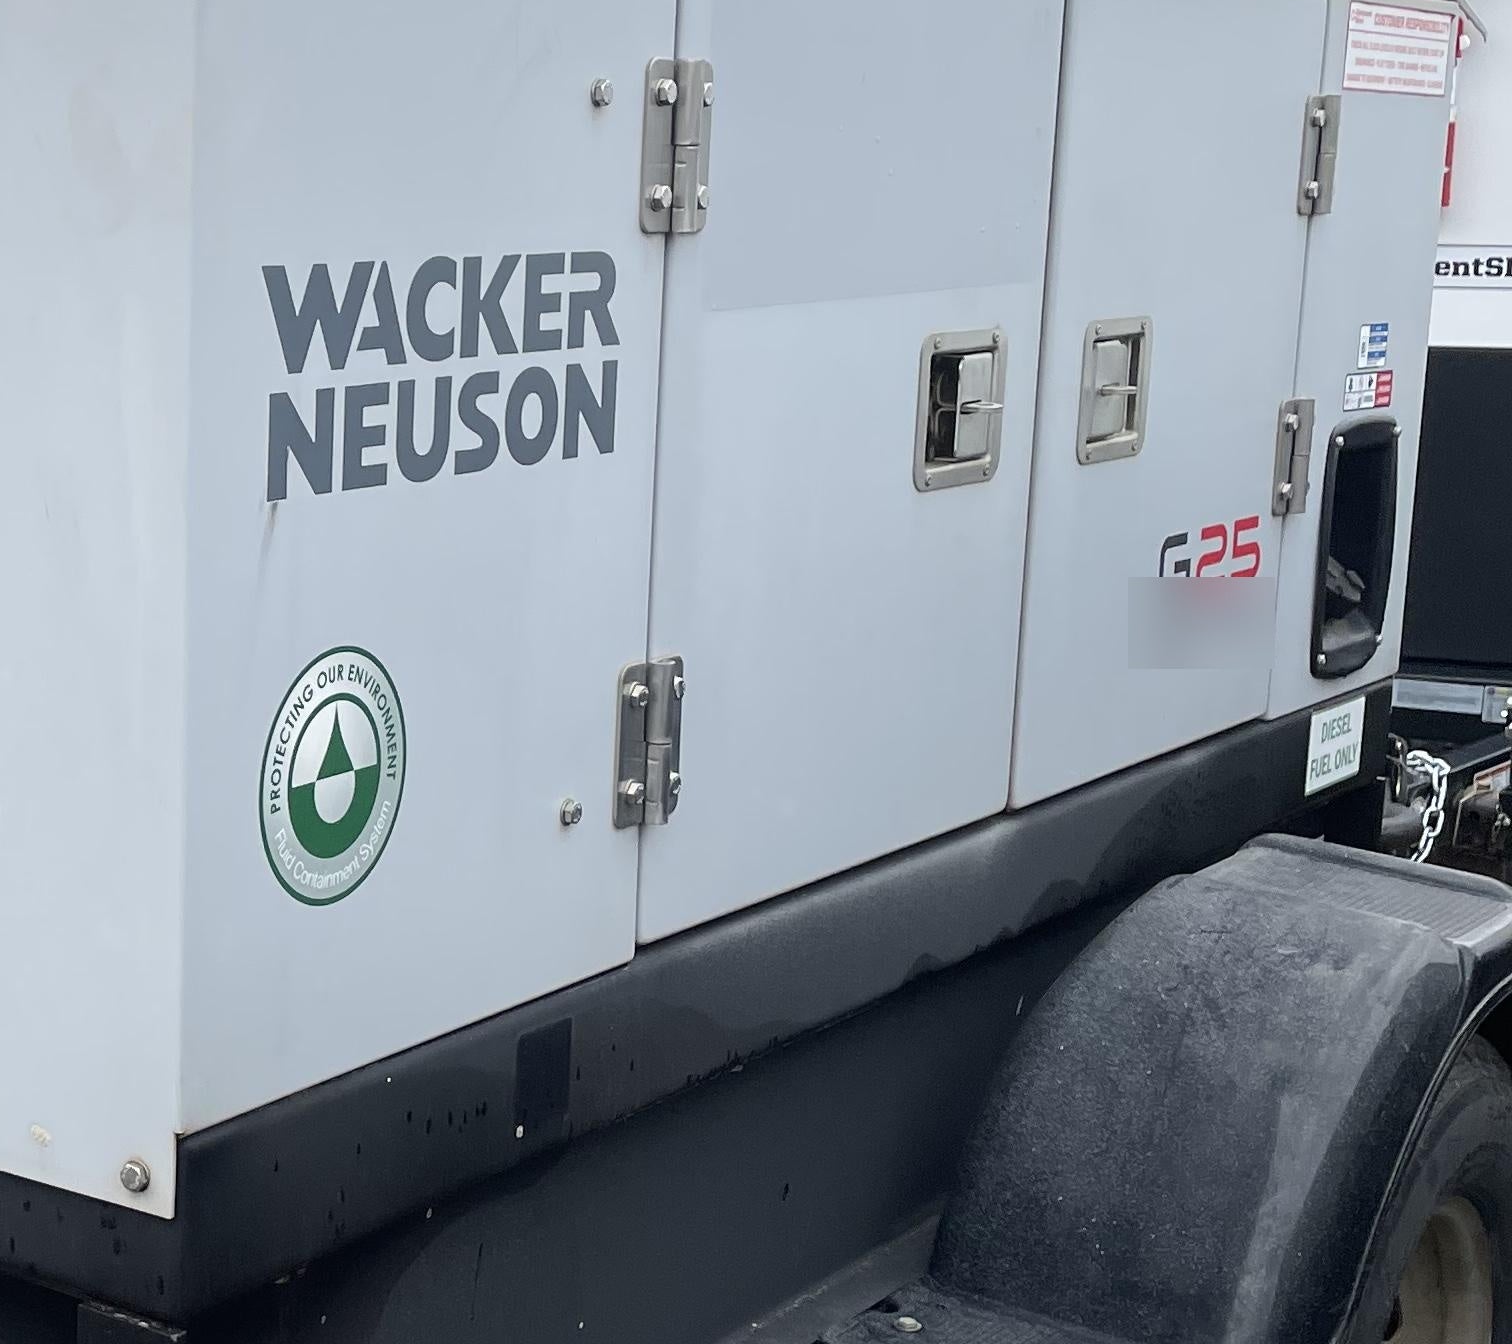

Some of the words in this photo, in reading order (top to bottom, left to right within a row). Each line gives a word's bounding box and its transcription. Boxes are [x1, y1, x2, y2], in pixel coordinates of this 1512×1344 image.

[261, 250, 621, 375] WACKER
[267, 359, 619, 503] NEUSON
[1159, 515, 1261, 577] G25
[270, 684, 315, 815] PROTECTING
[316, 663, 345, 689] OUR
[348, 664, 398, 780] ENVIRONMENT
[1321, 713, 1352, 744] DIESEL
[1310, 753, 1332, 780] FUEL
[1335, 742, 1359, 770] ONLY
[274, 827, 294, 870] Fluid
[293, 855, 361, 890] Containment
